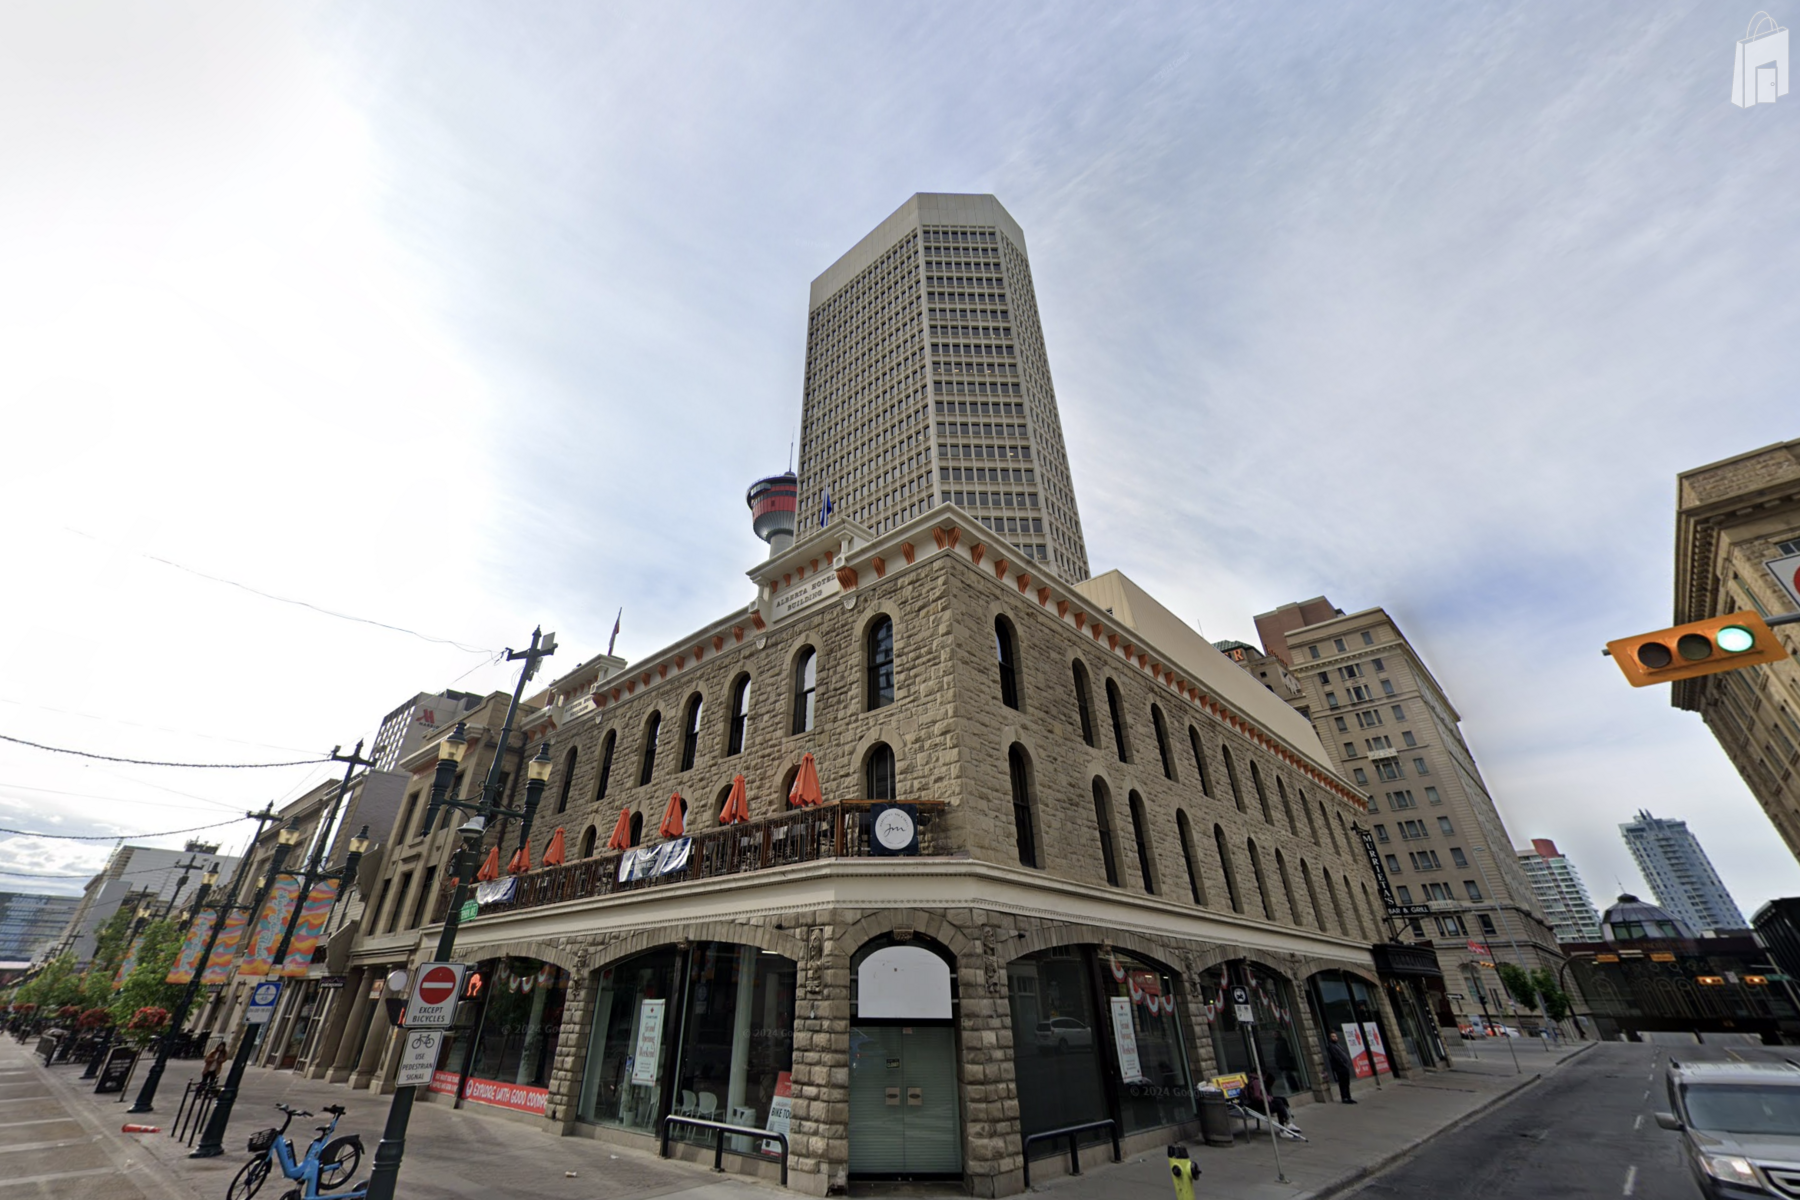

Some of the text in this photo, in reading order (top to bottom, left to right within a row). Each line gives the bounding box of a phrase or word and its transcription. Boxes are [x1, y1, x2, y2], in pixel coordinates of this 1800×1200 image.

[776, 573, 836, 608] ALBERTA HOTEL
[787, 589, 823, 611] BUILDING
[419, 722, 440, 730] MARRIO
[1362, 834, 1395, 905] MURRIETA'S
[418, 1006, 444, 1014] EXCEPT
[412, 1015, 445, 1023] BICYCLES
[402, 1062, 433, 1071] PEDESTRIAN
[406, 1073, 424, 1081] SIGNAL
[472, 1082, 496, 1100] EXPLORE
[496, 1087, 510, 1102] WITH
[510, 1089, 526, 1106] GOOD
[771, 1106, 782, 1118] BIKE
